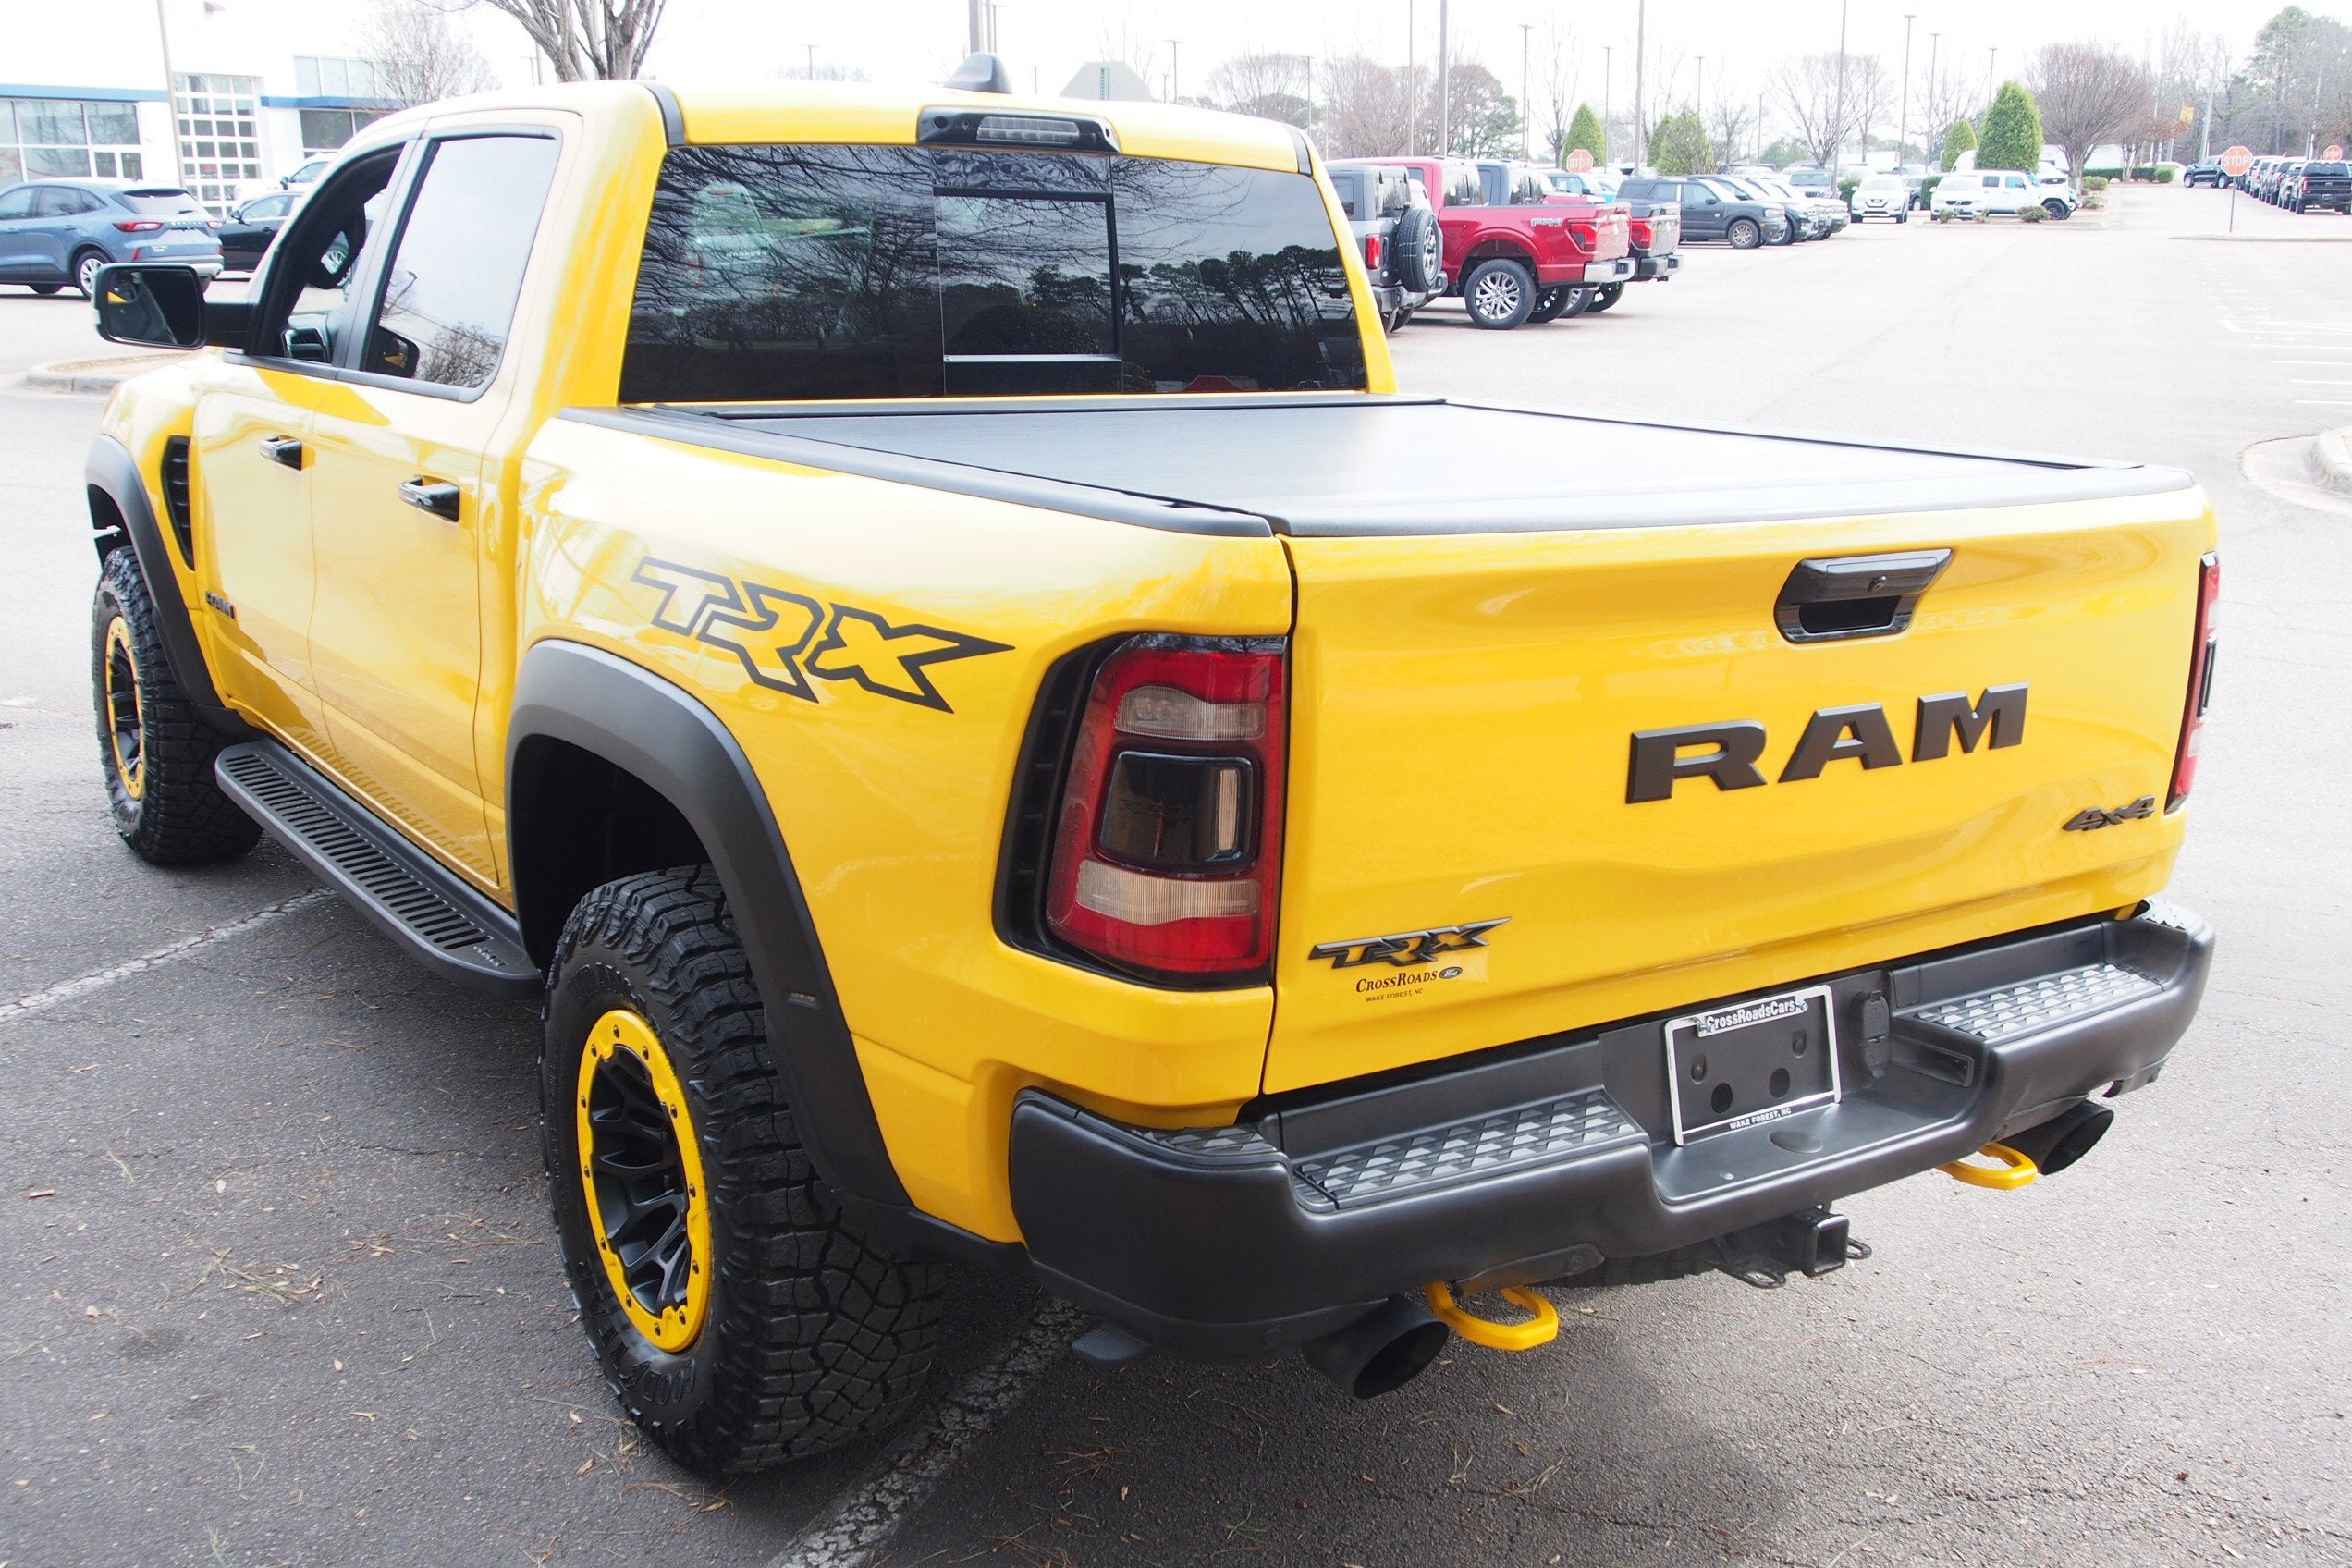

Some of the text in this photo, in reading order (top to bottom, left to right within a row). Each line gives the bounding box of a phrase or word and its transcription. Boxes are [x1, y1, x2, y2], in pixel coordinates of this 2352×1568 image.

[1569, 157, 1591, 168] STOP
[2223, 155, 2249, 167] STOP
[631, 555, 1015, 714] TRX
[1625, 681, 2030, 804] RAM
[1308, 916, 1513, 969] TRX
[1366, 993, 1385, 1003] WAKE
[1386, 989, 1413, 1000] FOREST,
[1706, 999, 1795, 1030] CrossRoadsCars
[1729, 1108, 1792, 1130] WAKE FOREST, NC
